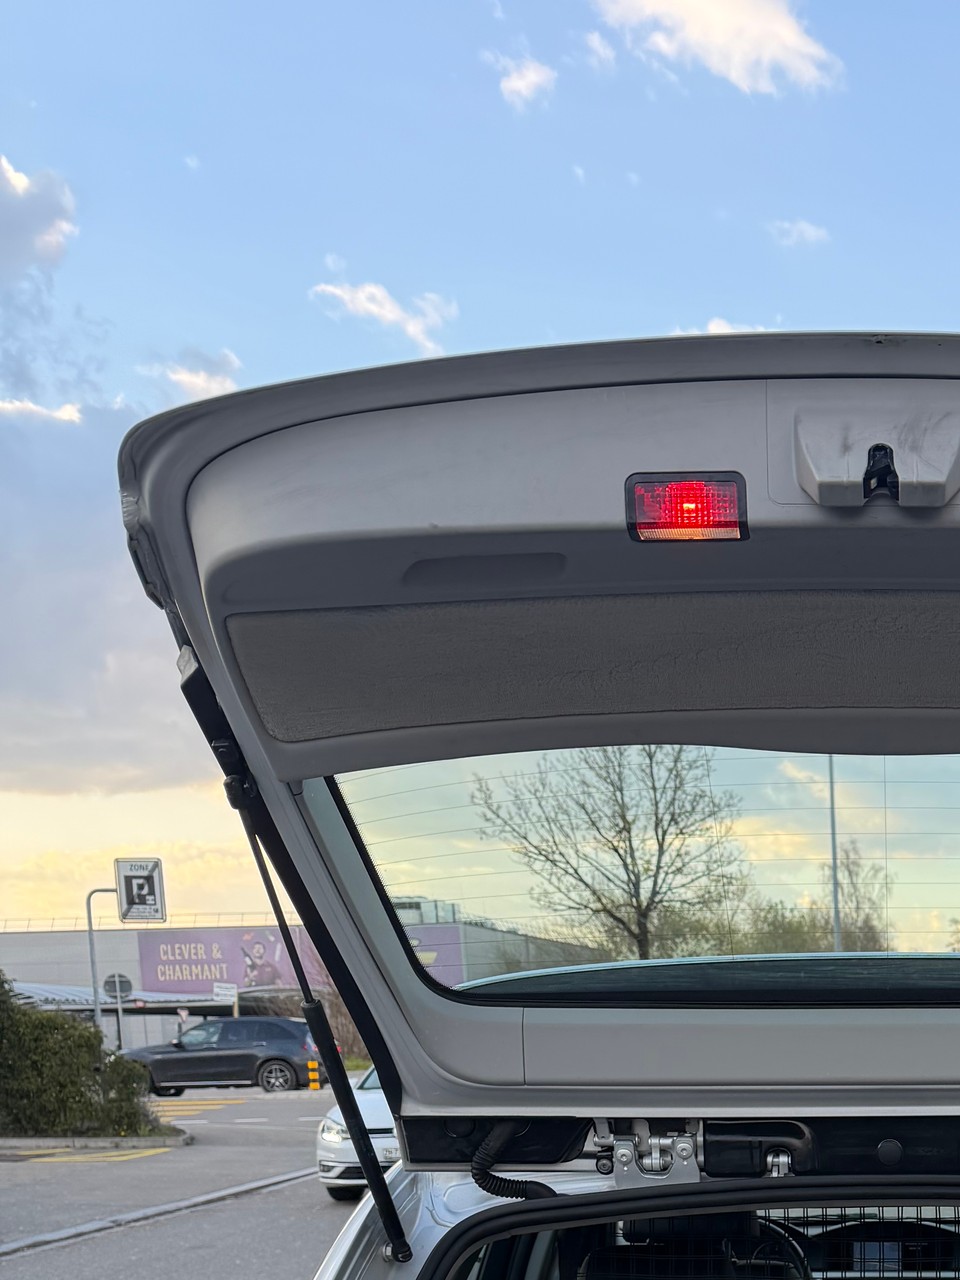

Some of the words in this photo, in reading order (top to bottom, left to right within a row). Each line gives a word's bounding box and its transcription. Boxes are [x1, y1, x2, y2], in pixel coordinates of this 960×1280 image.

[129, 864, 150, 872] ZONE
[160, 943, 206, 961] CLEVER
[211, 942, 222, 960] &
[157, 963, 228, 981] CHARMANT
